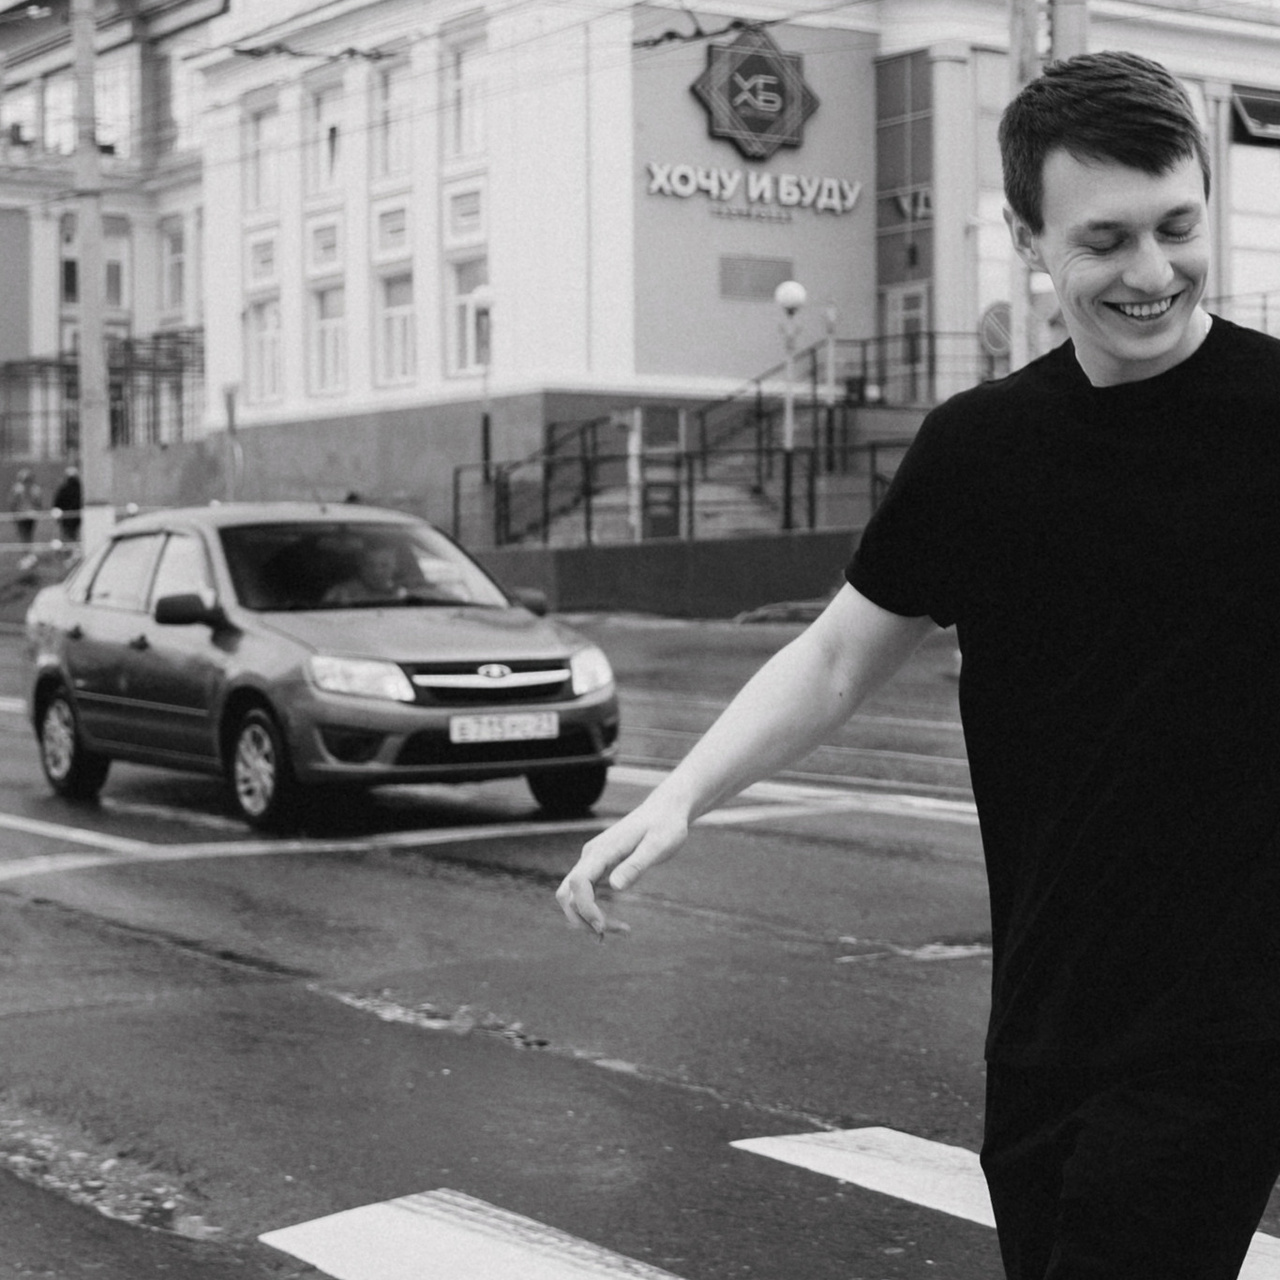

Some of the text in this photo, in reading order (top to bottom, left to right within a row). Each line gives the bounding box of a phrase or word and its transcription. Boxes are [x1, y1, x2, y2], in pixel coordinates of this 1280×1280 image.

[648, 164, 739, 200] ХОЧУ
[749, 171, 773, 203] И
[779, 175, 862, 214] БУДУ
